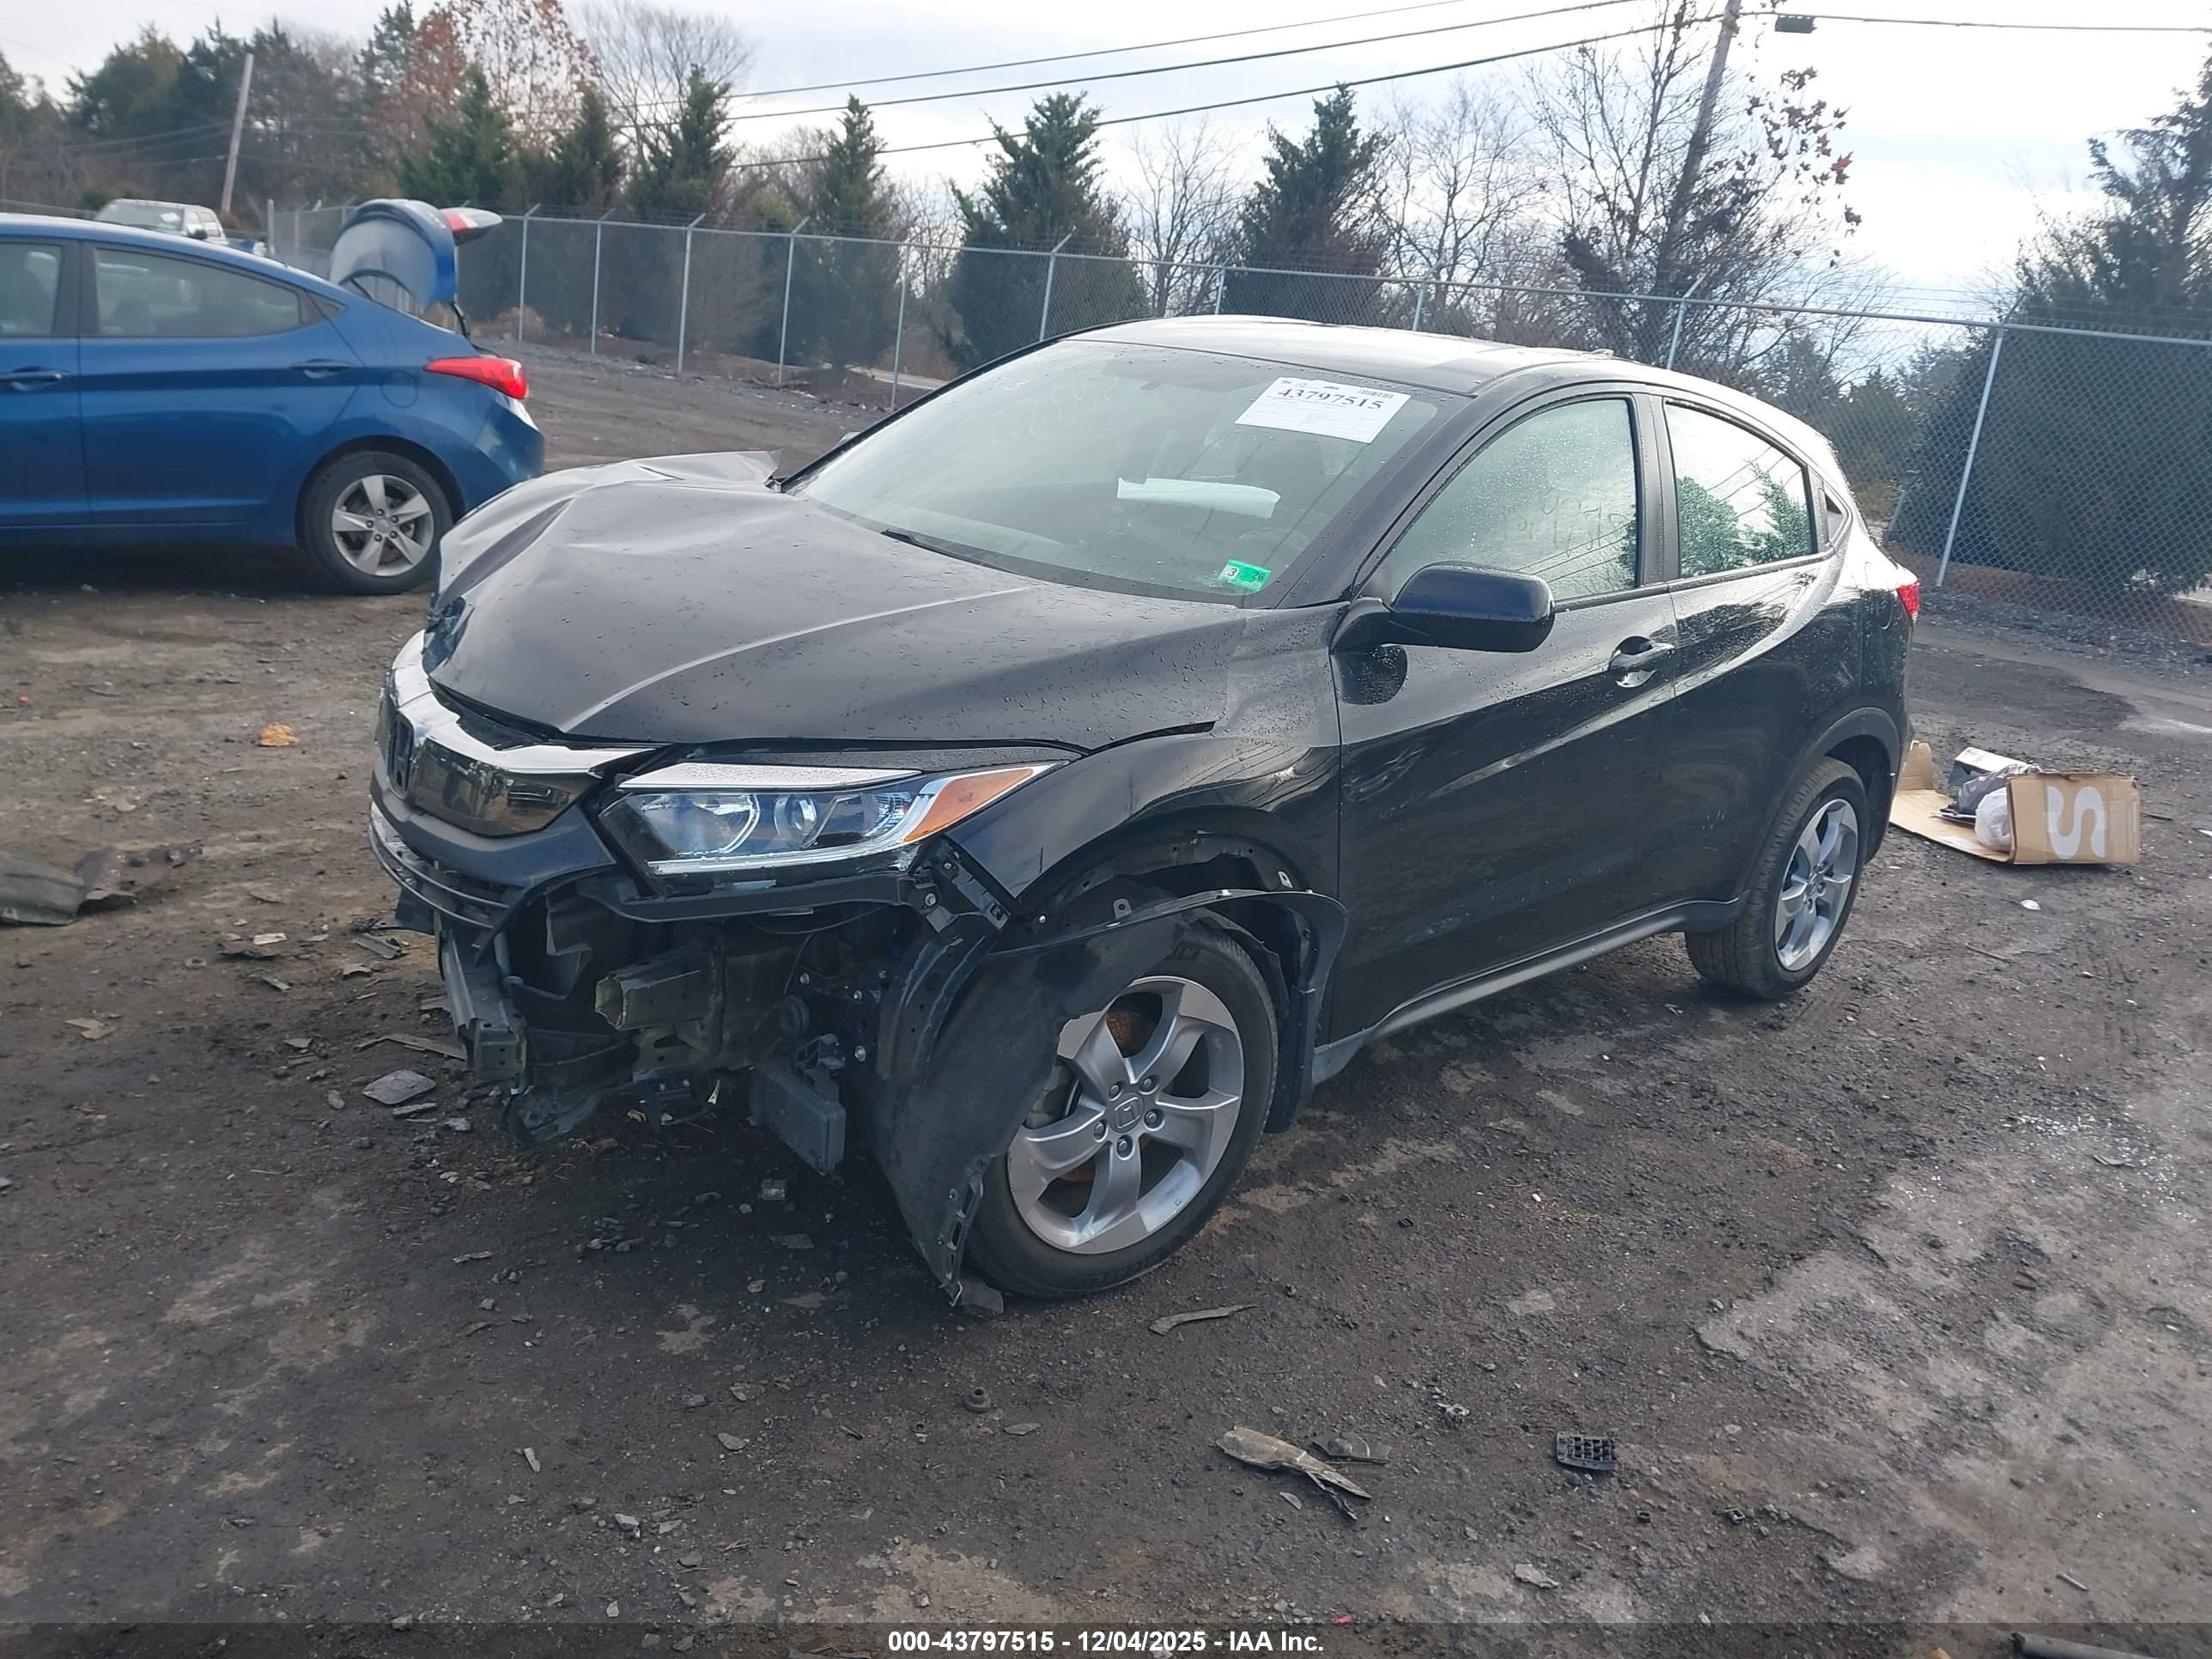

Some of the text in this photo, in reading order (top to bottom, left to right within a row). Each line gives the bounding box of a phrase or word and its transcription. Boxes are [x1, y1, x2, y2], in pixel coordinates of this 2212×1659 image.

[1278, 388, 1385, 410] 43797515
[1228, 568, 1266, 580] 3 26
